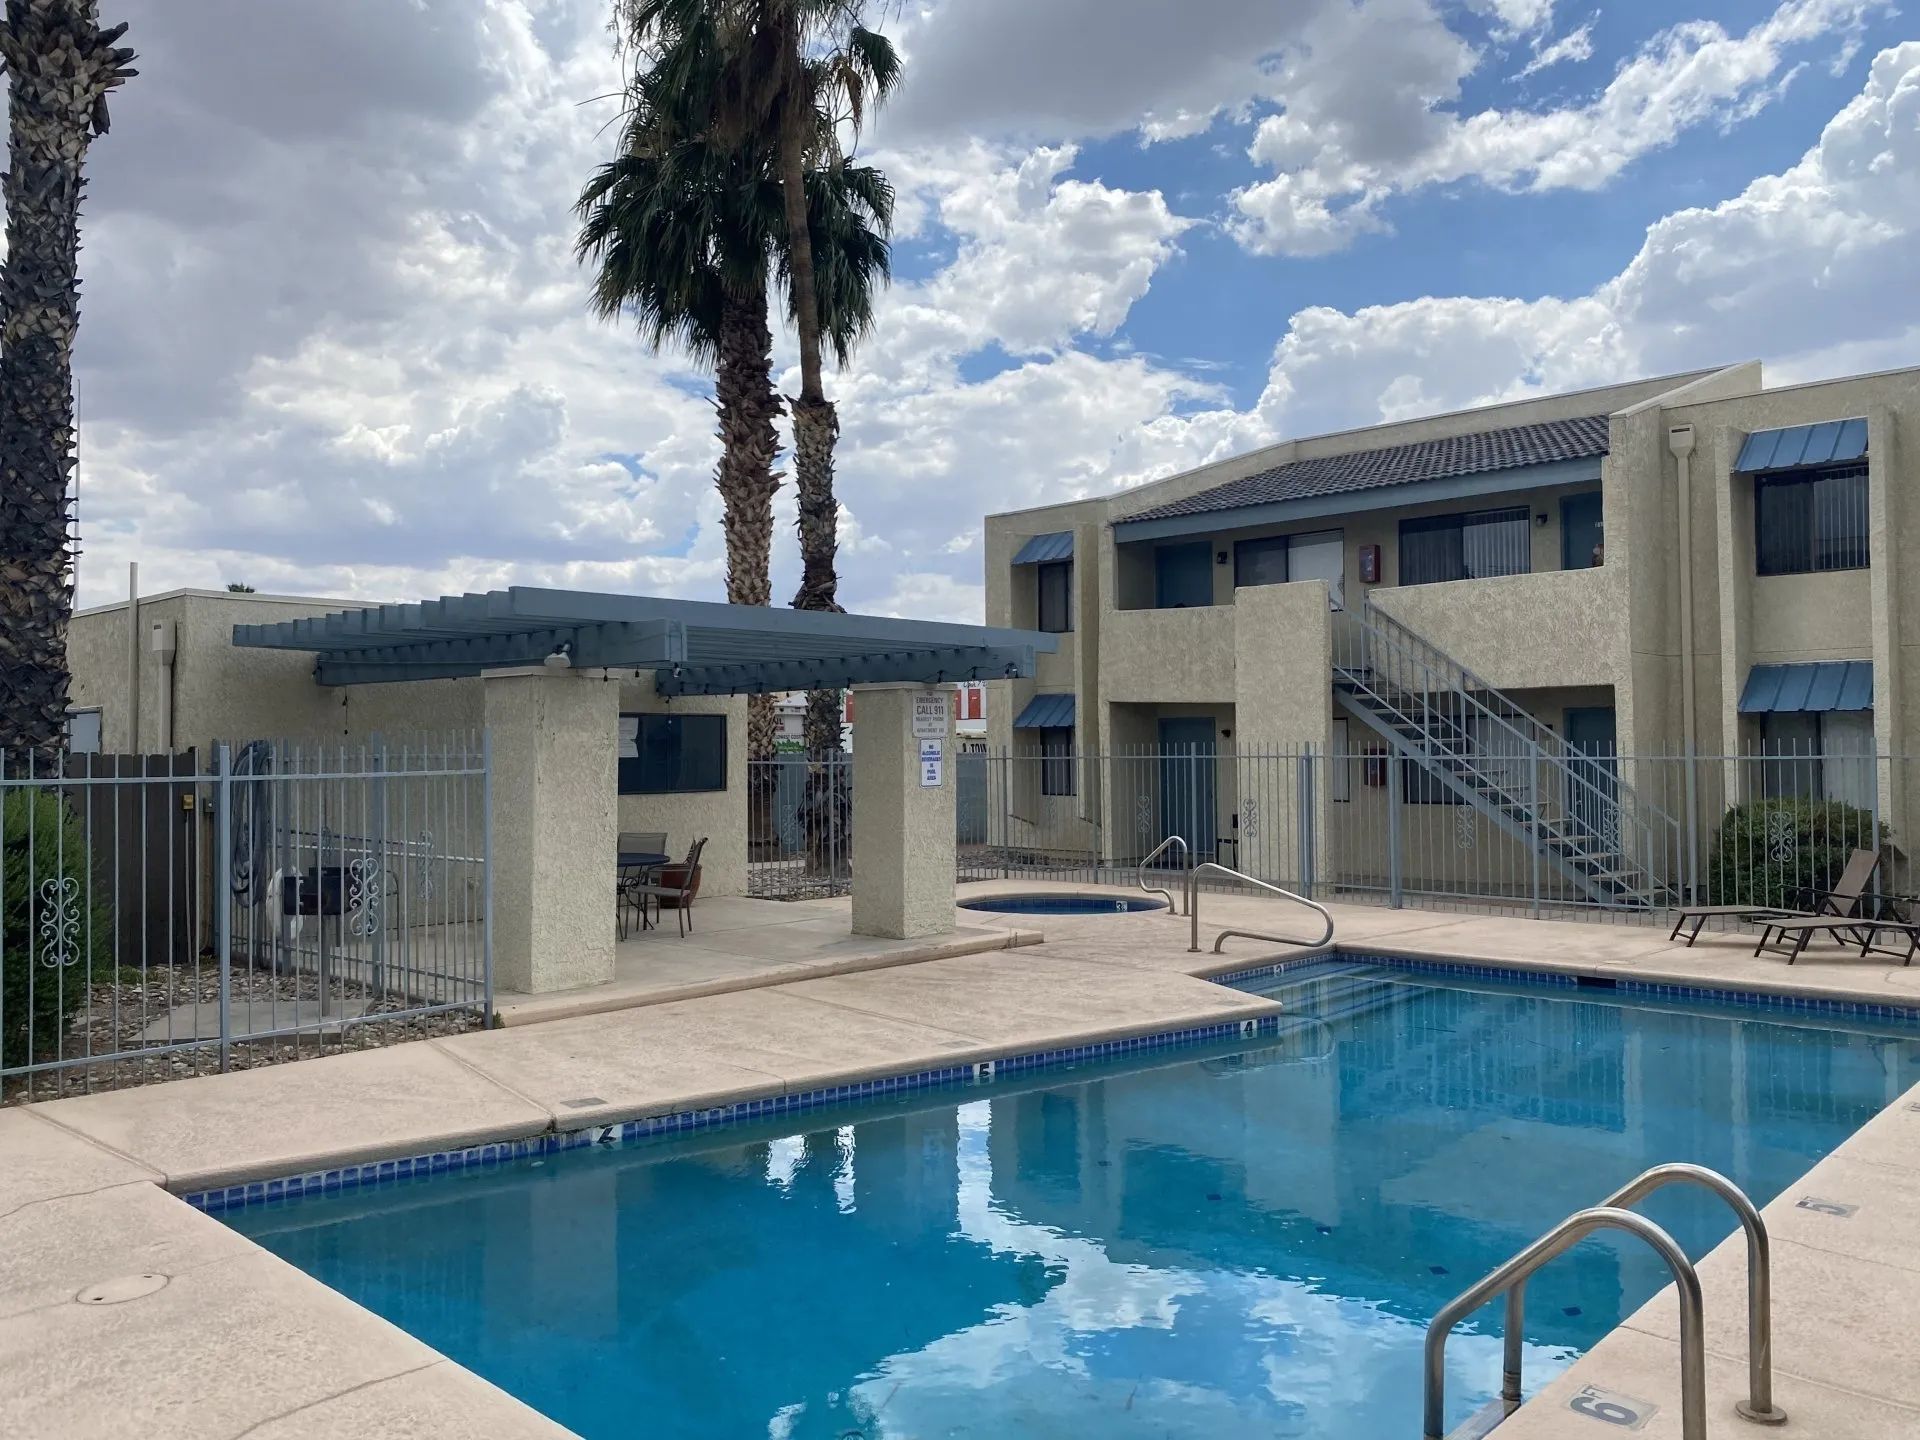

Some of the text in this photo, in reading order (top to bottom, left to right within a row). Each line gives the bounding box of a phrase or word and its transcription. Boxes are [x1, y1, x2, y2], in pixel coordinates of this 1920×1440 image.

[916, 705, 944, 715] CALL 911
[979, 1063, 990, 1077] 5
[1570, 1396, 1639, 1426] 6
